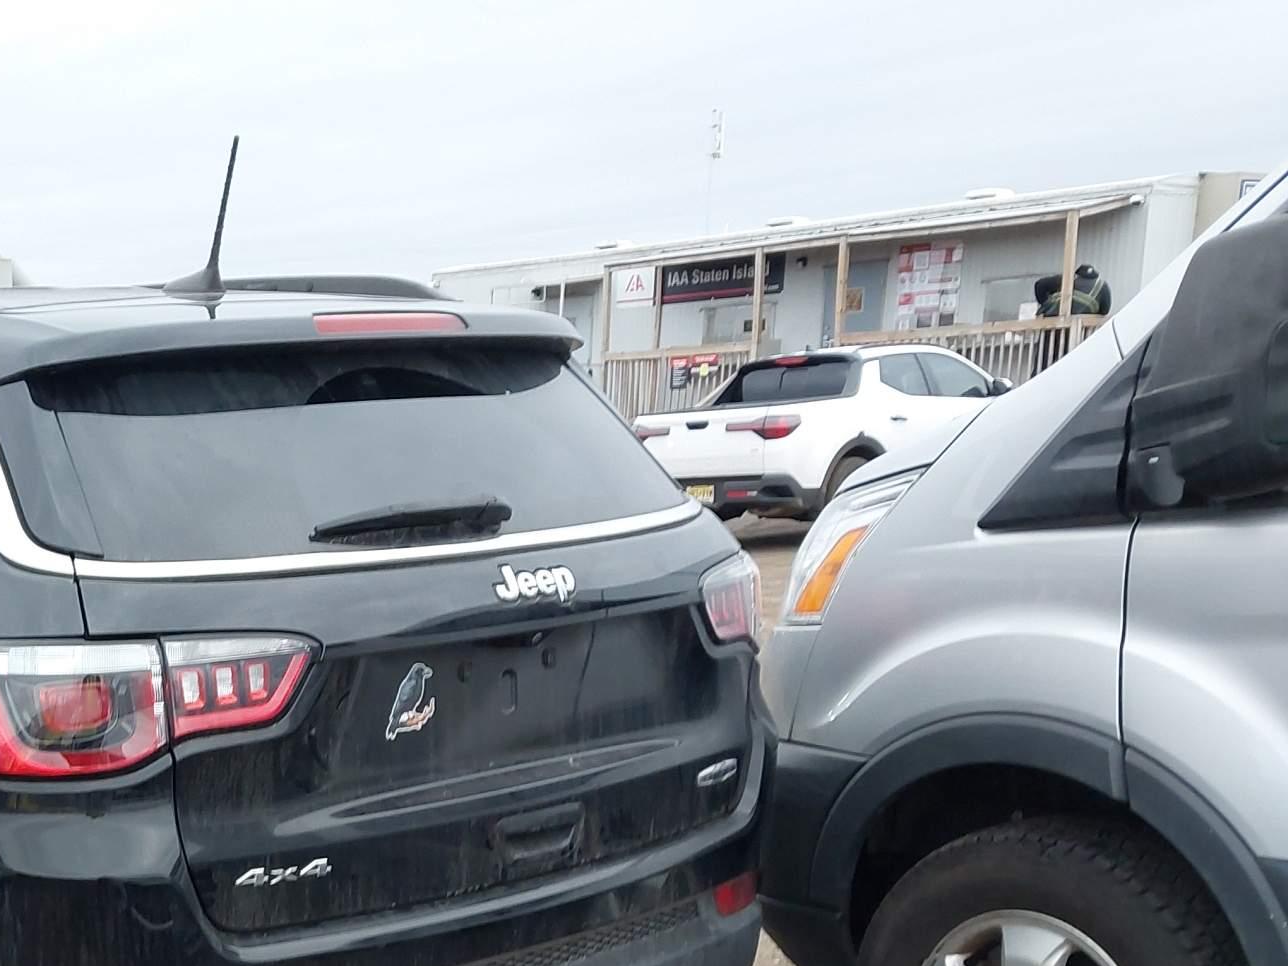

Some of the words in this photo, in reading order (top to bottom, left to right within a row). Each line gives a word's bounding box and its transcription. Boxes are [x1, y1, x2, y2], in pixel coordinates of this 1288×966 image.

[667, 271, 689, 288] IAA
[692, 268, 730, 285] Staten
[732, 261, 770, 280] Islad
[493, 563, 576, 603] Jeep
